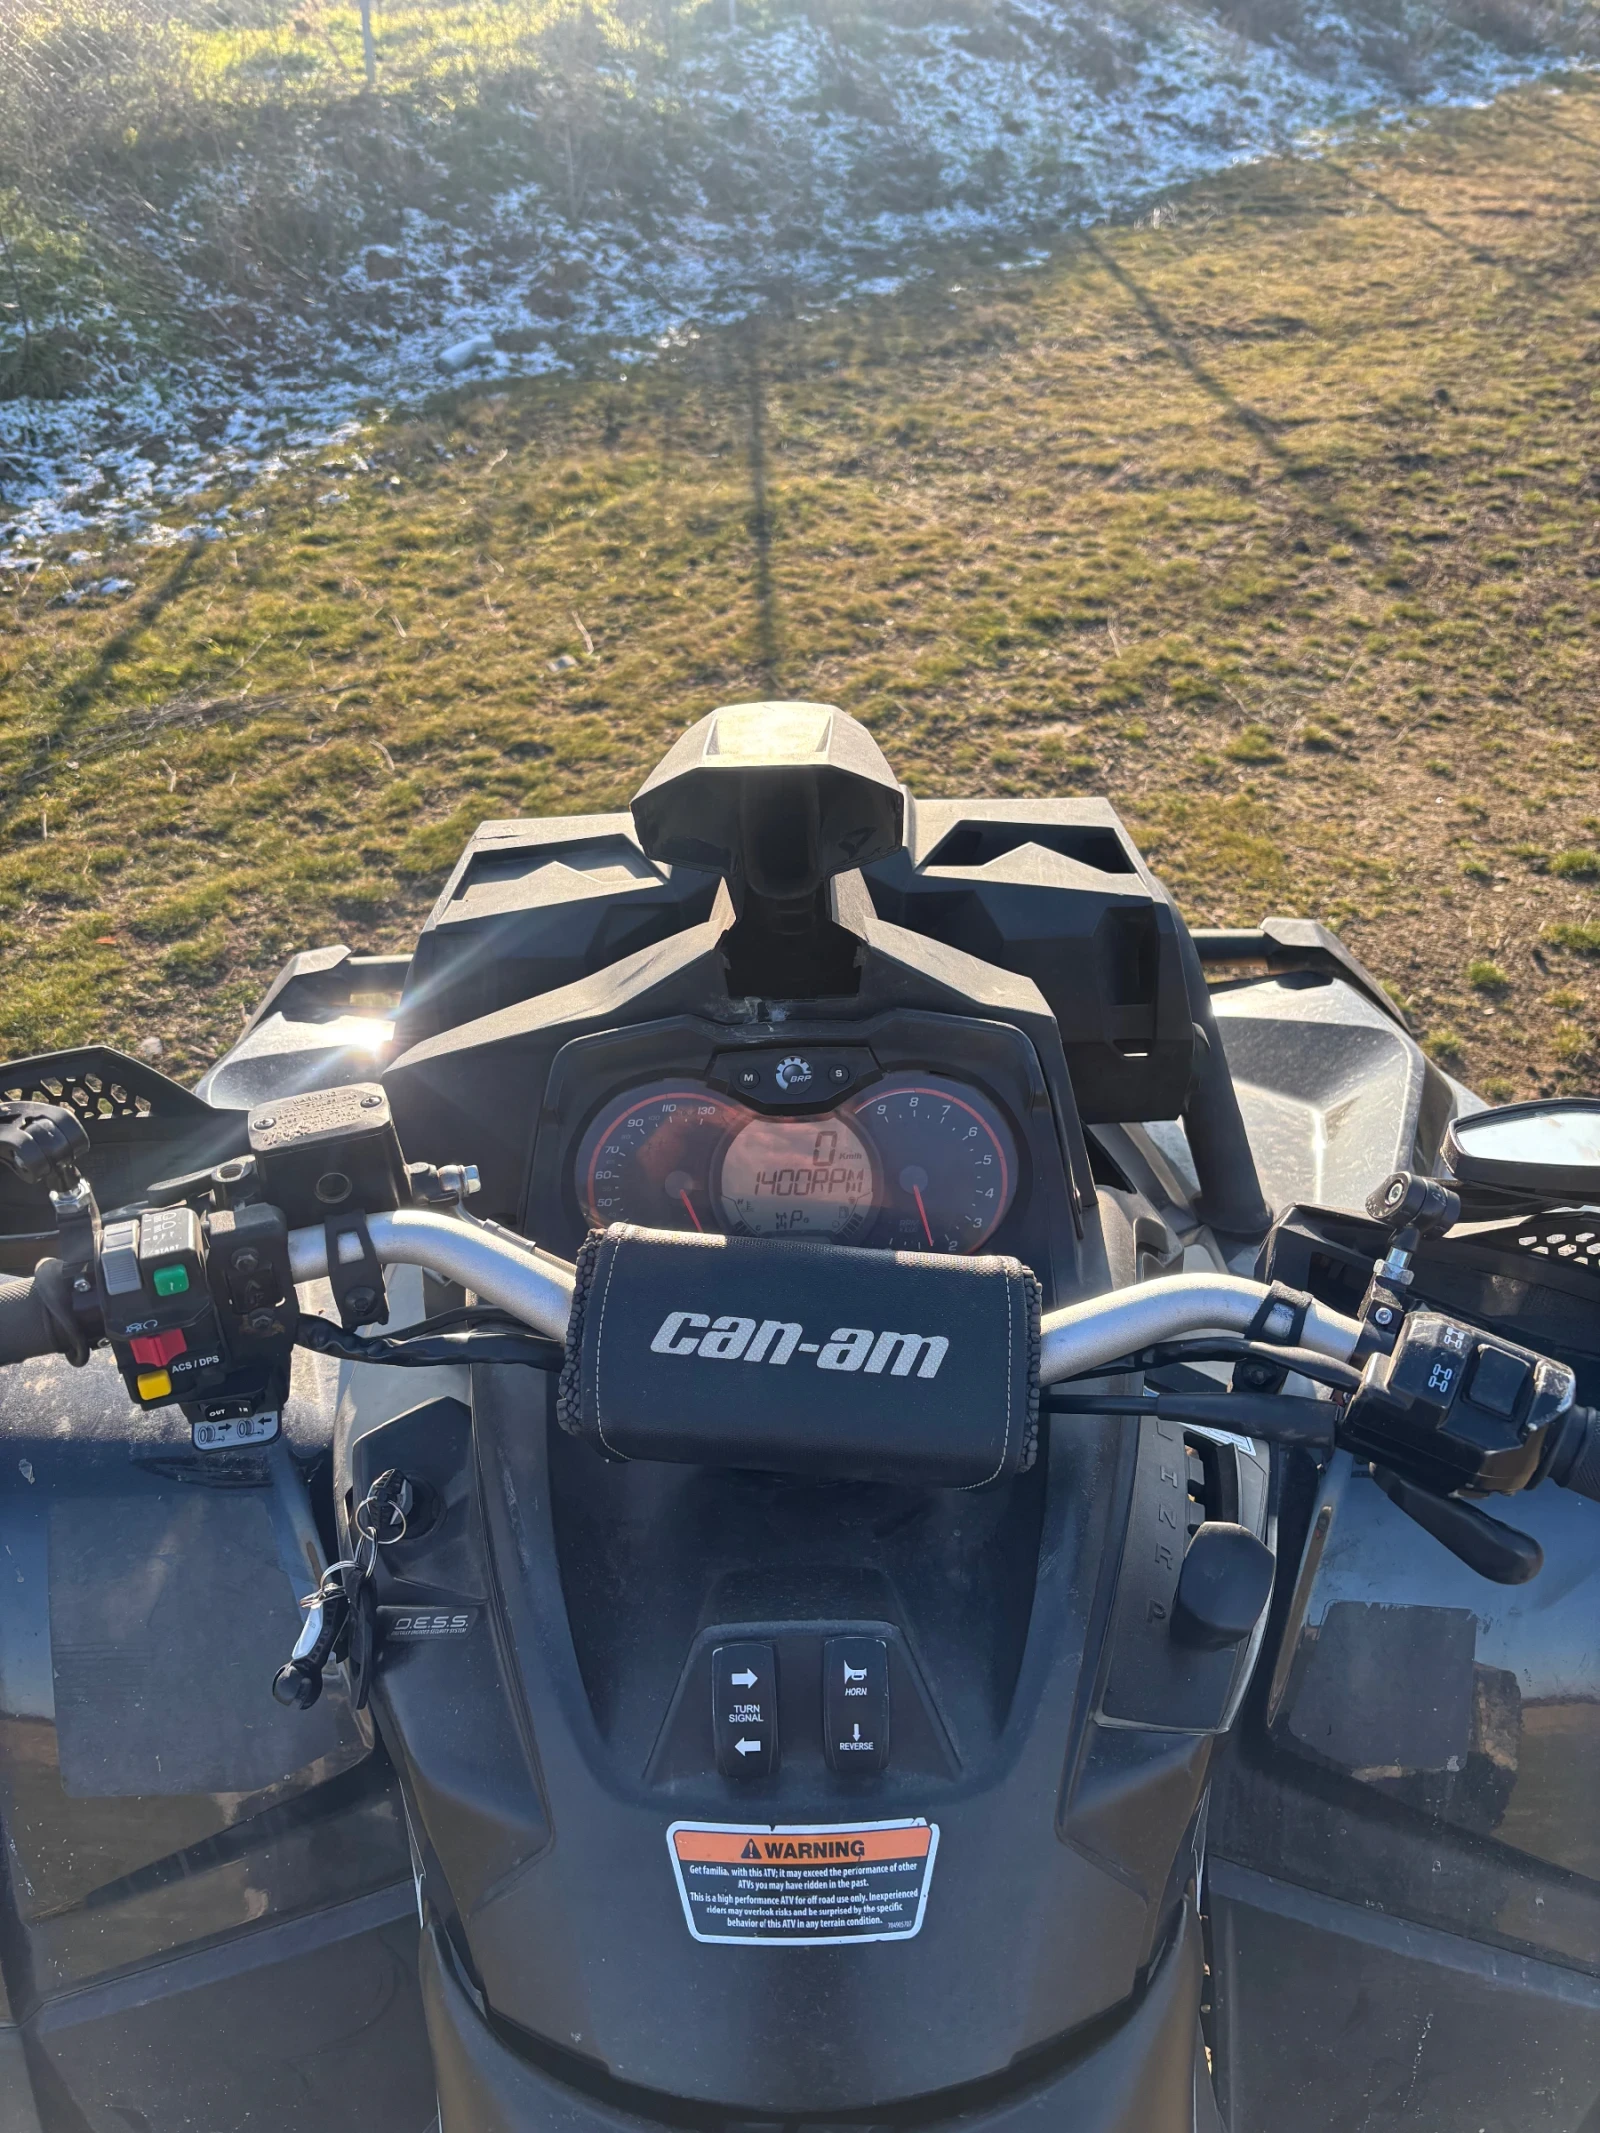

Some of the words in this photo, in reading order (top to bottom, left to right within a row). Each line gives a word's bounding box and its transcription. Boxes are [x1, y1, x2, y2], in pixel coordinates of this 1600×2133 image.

[744, 1074, 754, 1082] M
[790, 1075, 812, 1083] BRP
[909, 1097, 919, 1107] 8
[662, 1104, 677, 1112] 110
[697, 1106, 715, 1115] 130
[877, 1104, 887, 1115] 9
[942, 1105, 951, 1115] 7
[627, 1118, 644, 1128] 90
[968, 1127, 978, 1137] 6
[605, 1146, 620, 1154] 70
[813, 1131, 838, 1166] 0
[982, 1155, 992, 1165] 5
[595, 1171, 612, 1179] 60
[985, 1188, 995, 1198] 4
[597, 1198, 612, 1207] 50
[973, 1218, 983, 1228] 3
[948, 1241, 958, 1251] 2
[650, 1311, 949, 1378] can-am
[172, 1361, 192, 1374] ACS
[199, 1355, 220, 1366] DPS
[209, 1409, 225, 1417] OUT
[1159, 1465, 1178, 1489] H
[394, 1615, 469, 1630] D.E.S.S.
[845, 1687, 867, 1696] HORN
[734, 1704, 760, 1713] TURN
[728, 1714, 764, 1722] SIGNAL
[839, 1742, 874, 1750] REVERSE
[764, 1840, 865, 1859] WARNING
[690, 1865, 701, 1875] Get
[731, 1867, 747, 1877] with
[749, 1867, 762, 1877] this
[763, 1868, 778, 1878] ATV;
[779, 1868, 785, 1878] it
[786, 1869, 801, 1879] may
[803, 1868, 828, 1878] exceed
[829, 1867, 841, 1876] the
[890, 1863, 897, 1872] of
[899, 1862, 917, 1871] other
[738, 1880, 754, 1889] ATVs
[769, 1882, 784, 1891] may
[786, 1880, 803, 1890] have
[804, 1880, 828, 1890] ridden
[829, 1880, 836, 1888] in
[838, 1879, 849, 1888] the
[851, 1878, 869, 1889] past.
[690, 1892, 703, 1901] This
[705, 1892, 711, 1902] is
[718, 1893, 733, 1905] high
[735, 1894, 779, 1905] performance
[780, 1896, 794, 1905] ATV
[795, 1895, 806, 1904] for
[807, 1895, 817, 1904] off
[819, 1894, 835, 1904] road
[851, 1892, 868, 1903] only.
[869, 1888, 918, 1902] Inexperienced
[728, 1907, 742, 1916] may
[775, 1907, 792, 1916] risks
[793, 1907, 807, 1916] and
[809, 1907, 817, 1915] be
[819, 1905, 852, 1917] surprised
[853, 1904, 862, 1915] by
[863, 1904, 876, 1913] the
[877, 1902, 903, 1914] specific
[727, 1917, 758, 1928] behavior
[767, 1919, 781, 1928] this
[782, 1919, 797, 1928] ATV
[797, 1919, 804, 1928] in
[805, 1920, 820, 1930] any
[820, 1918, 845, 1928] terrain
[847, 1916, 883, 1927] condition.
